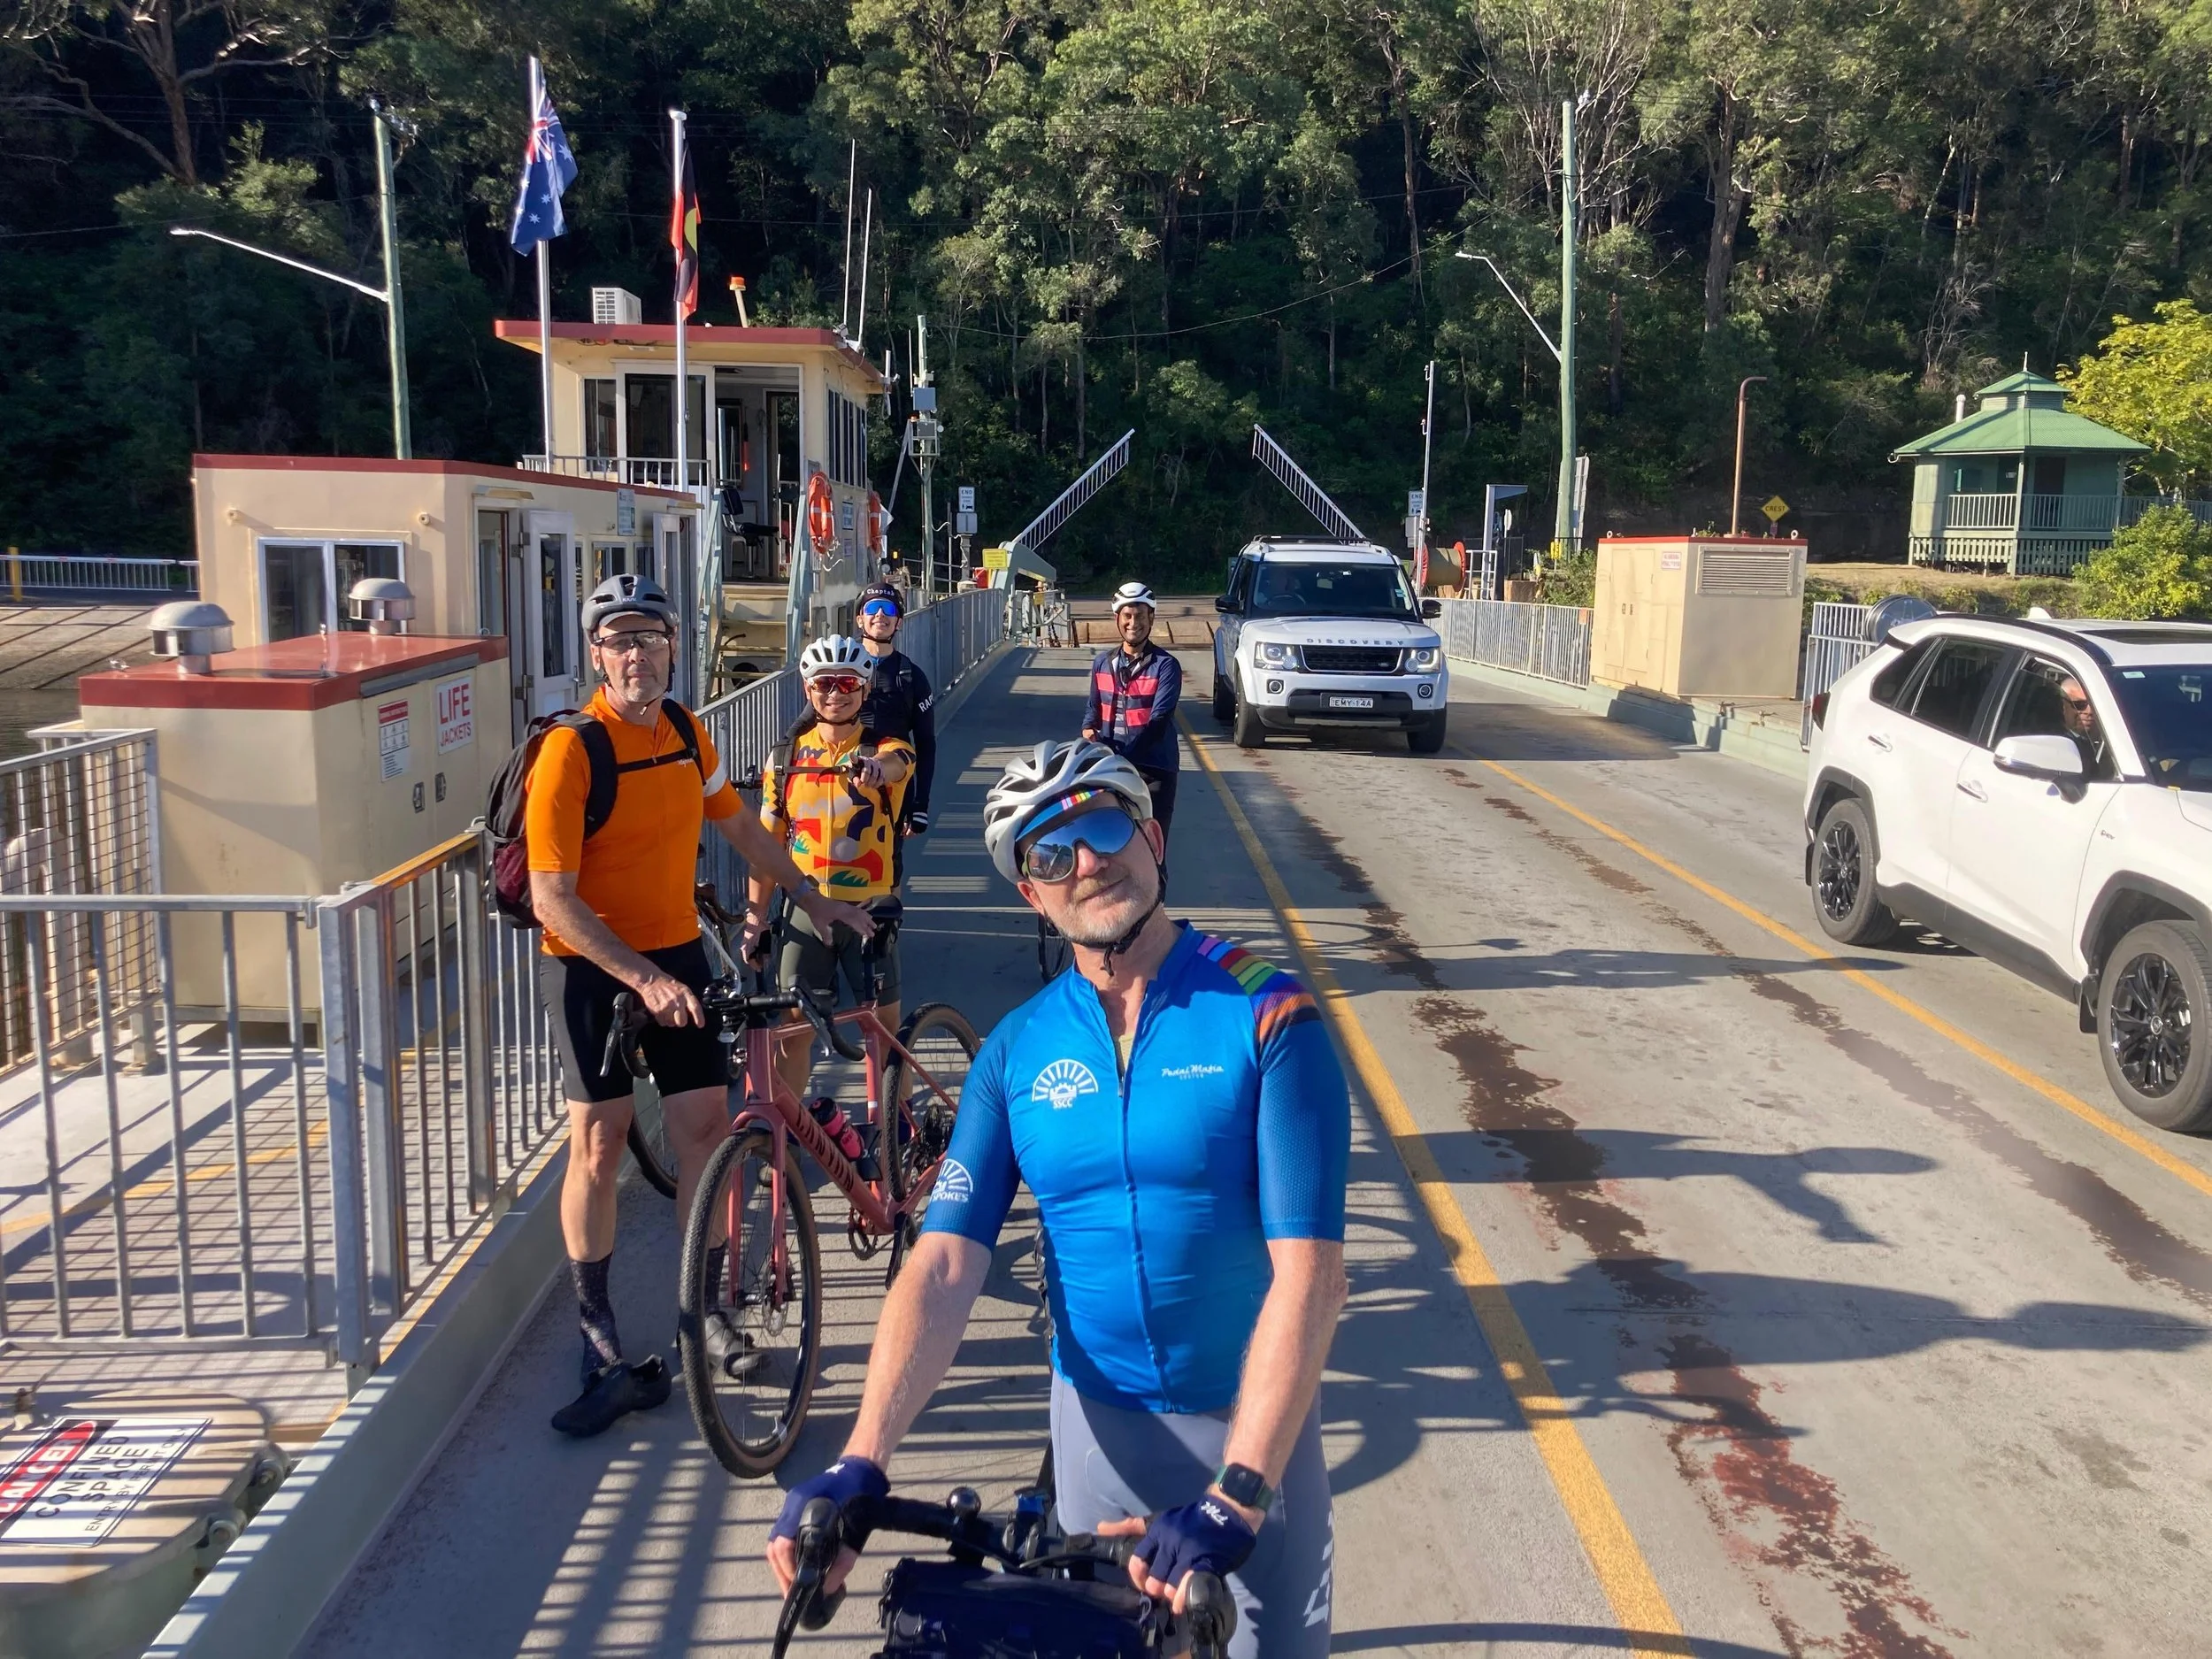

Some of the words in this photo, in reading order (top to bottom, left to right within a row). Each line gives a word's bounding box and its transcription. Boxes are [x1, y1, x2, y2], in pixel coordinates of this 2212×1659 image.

[439, 683, 471, 725] LIFE
[441, 722, 472, 748] JACKETS
[1053, 1098, 1073, 1109] SSCC
[35, 1436, 130, 1517] CONFINED
[81, 1448, 150, 1502] SPACE
[84, 1500, 122, 1532] ENTRY
[115, 1484, 134, 1497] BY
